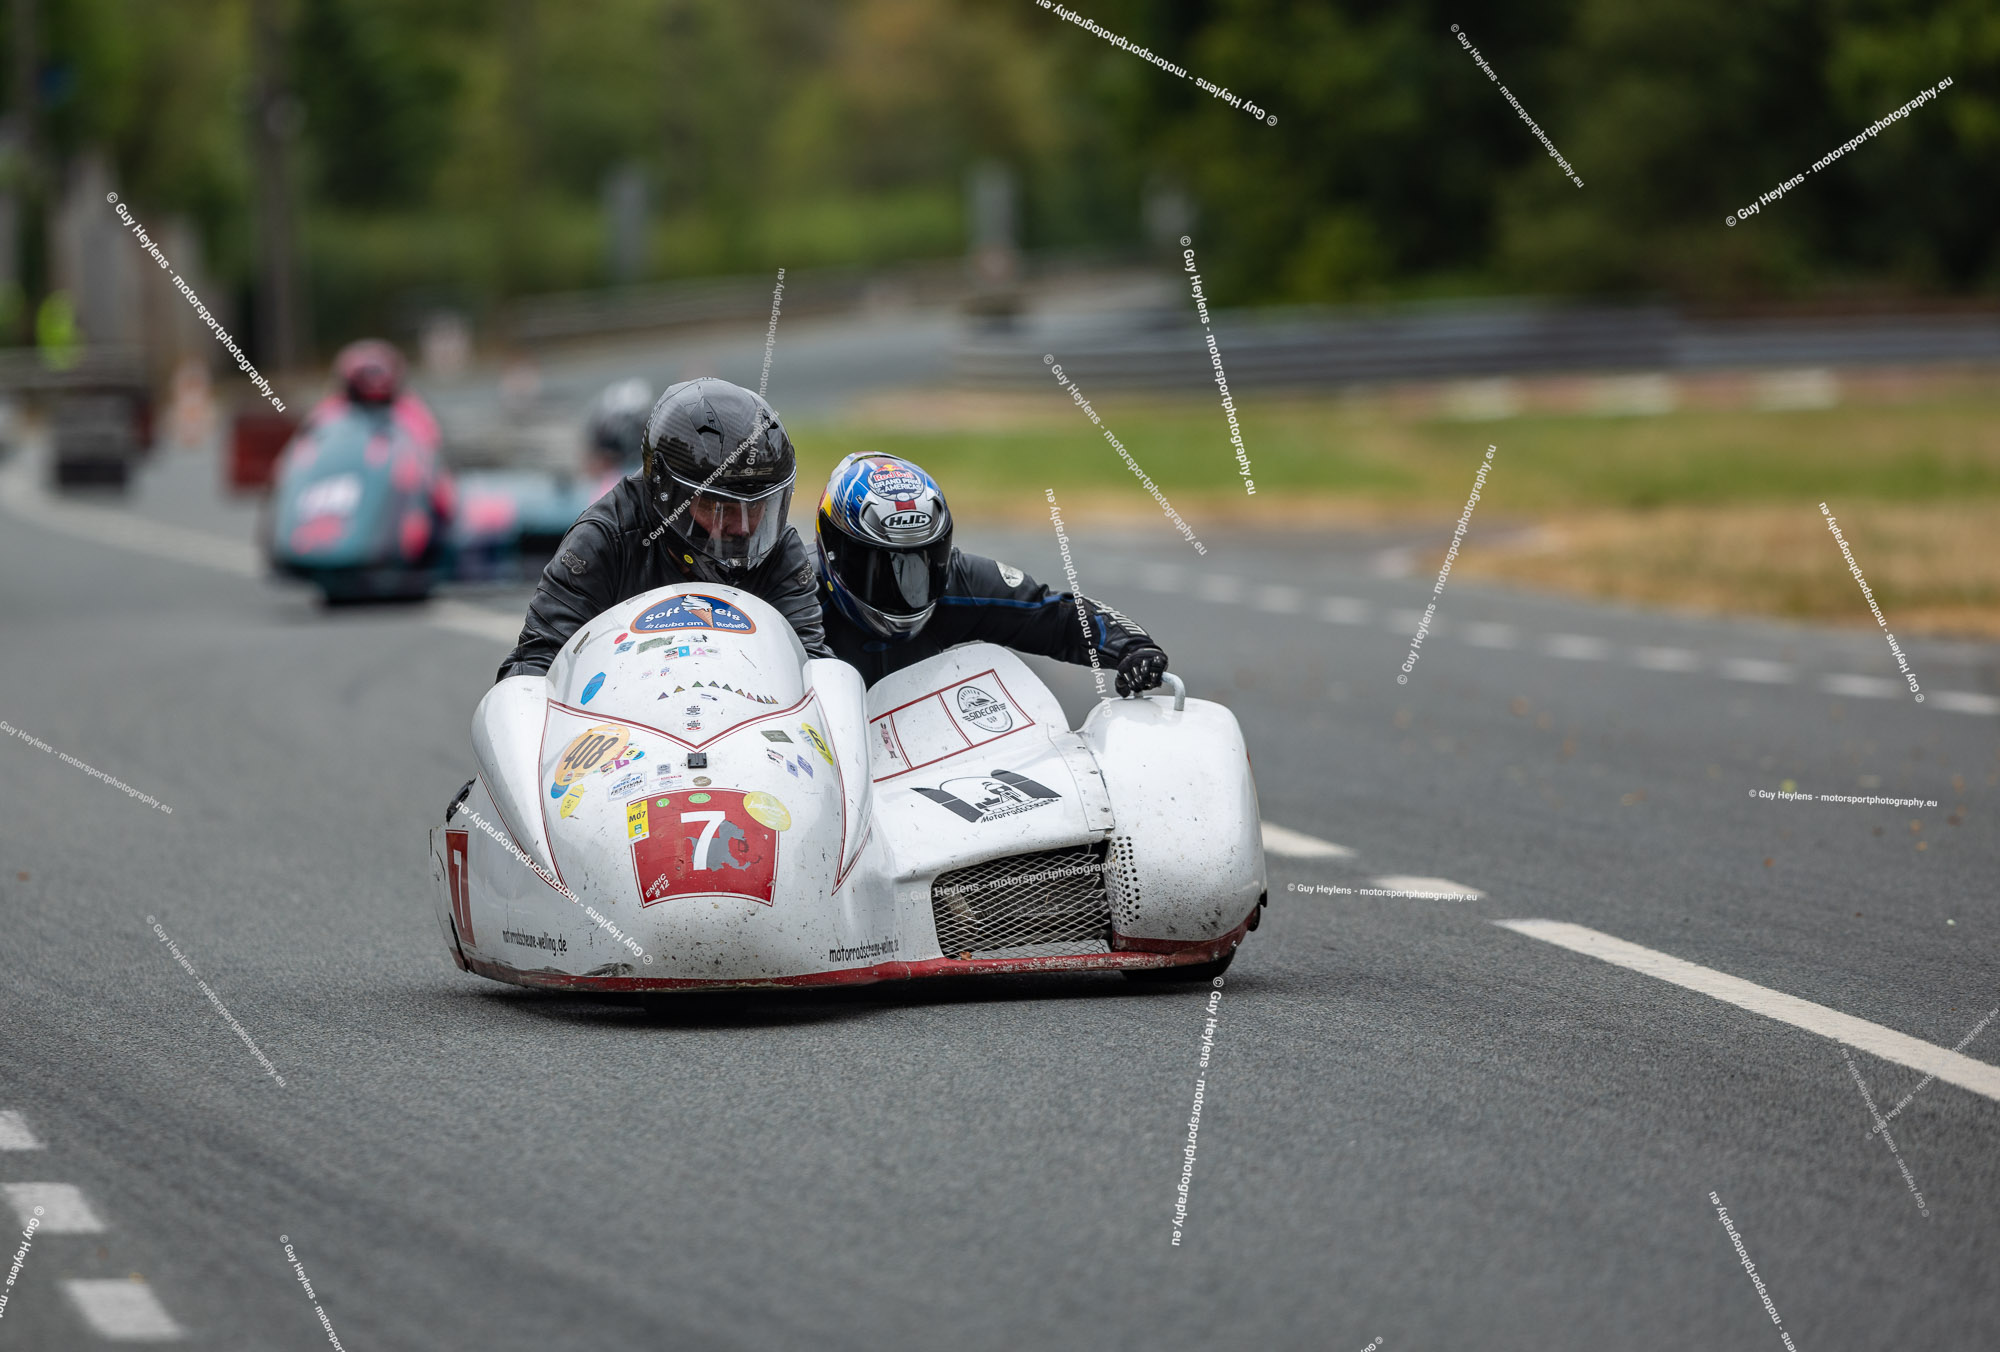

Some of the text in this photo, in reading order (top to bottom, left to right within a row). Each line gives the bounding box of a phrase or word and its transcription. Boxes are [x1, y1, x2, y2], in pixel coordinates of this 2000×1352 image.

[723, 467, 774, 477] LS2
[873, 471, 895, 481] Red
[873, 478, 902, 488] GRAND
[884, 483, 922, 492] AMERICAS
[888, 514, 927, 527] HJC
[644, 606, 680, 623] Soft
[654, 621, 685, 629] Leuba
[968, 704, 1001, 721] SIDECAR
[563, 734, 619, 770] 408
[628, 810, 647, 823] M07
[680, 810, 726, 871] 7
[645, 873, 667, 898] ENRIC
[654, 879, 670, 898] #12
